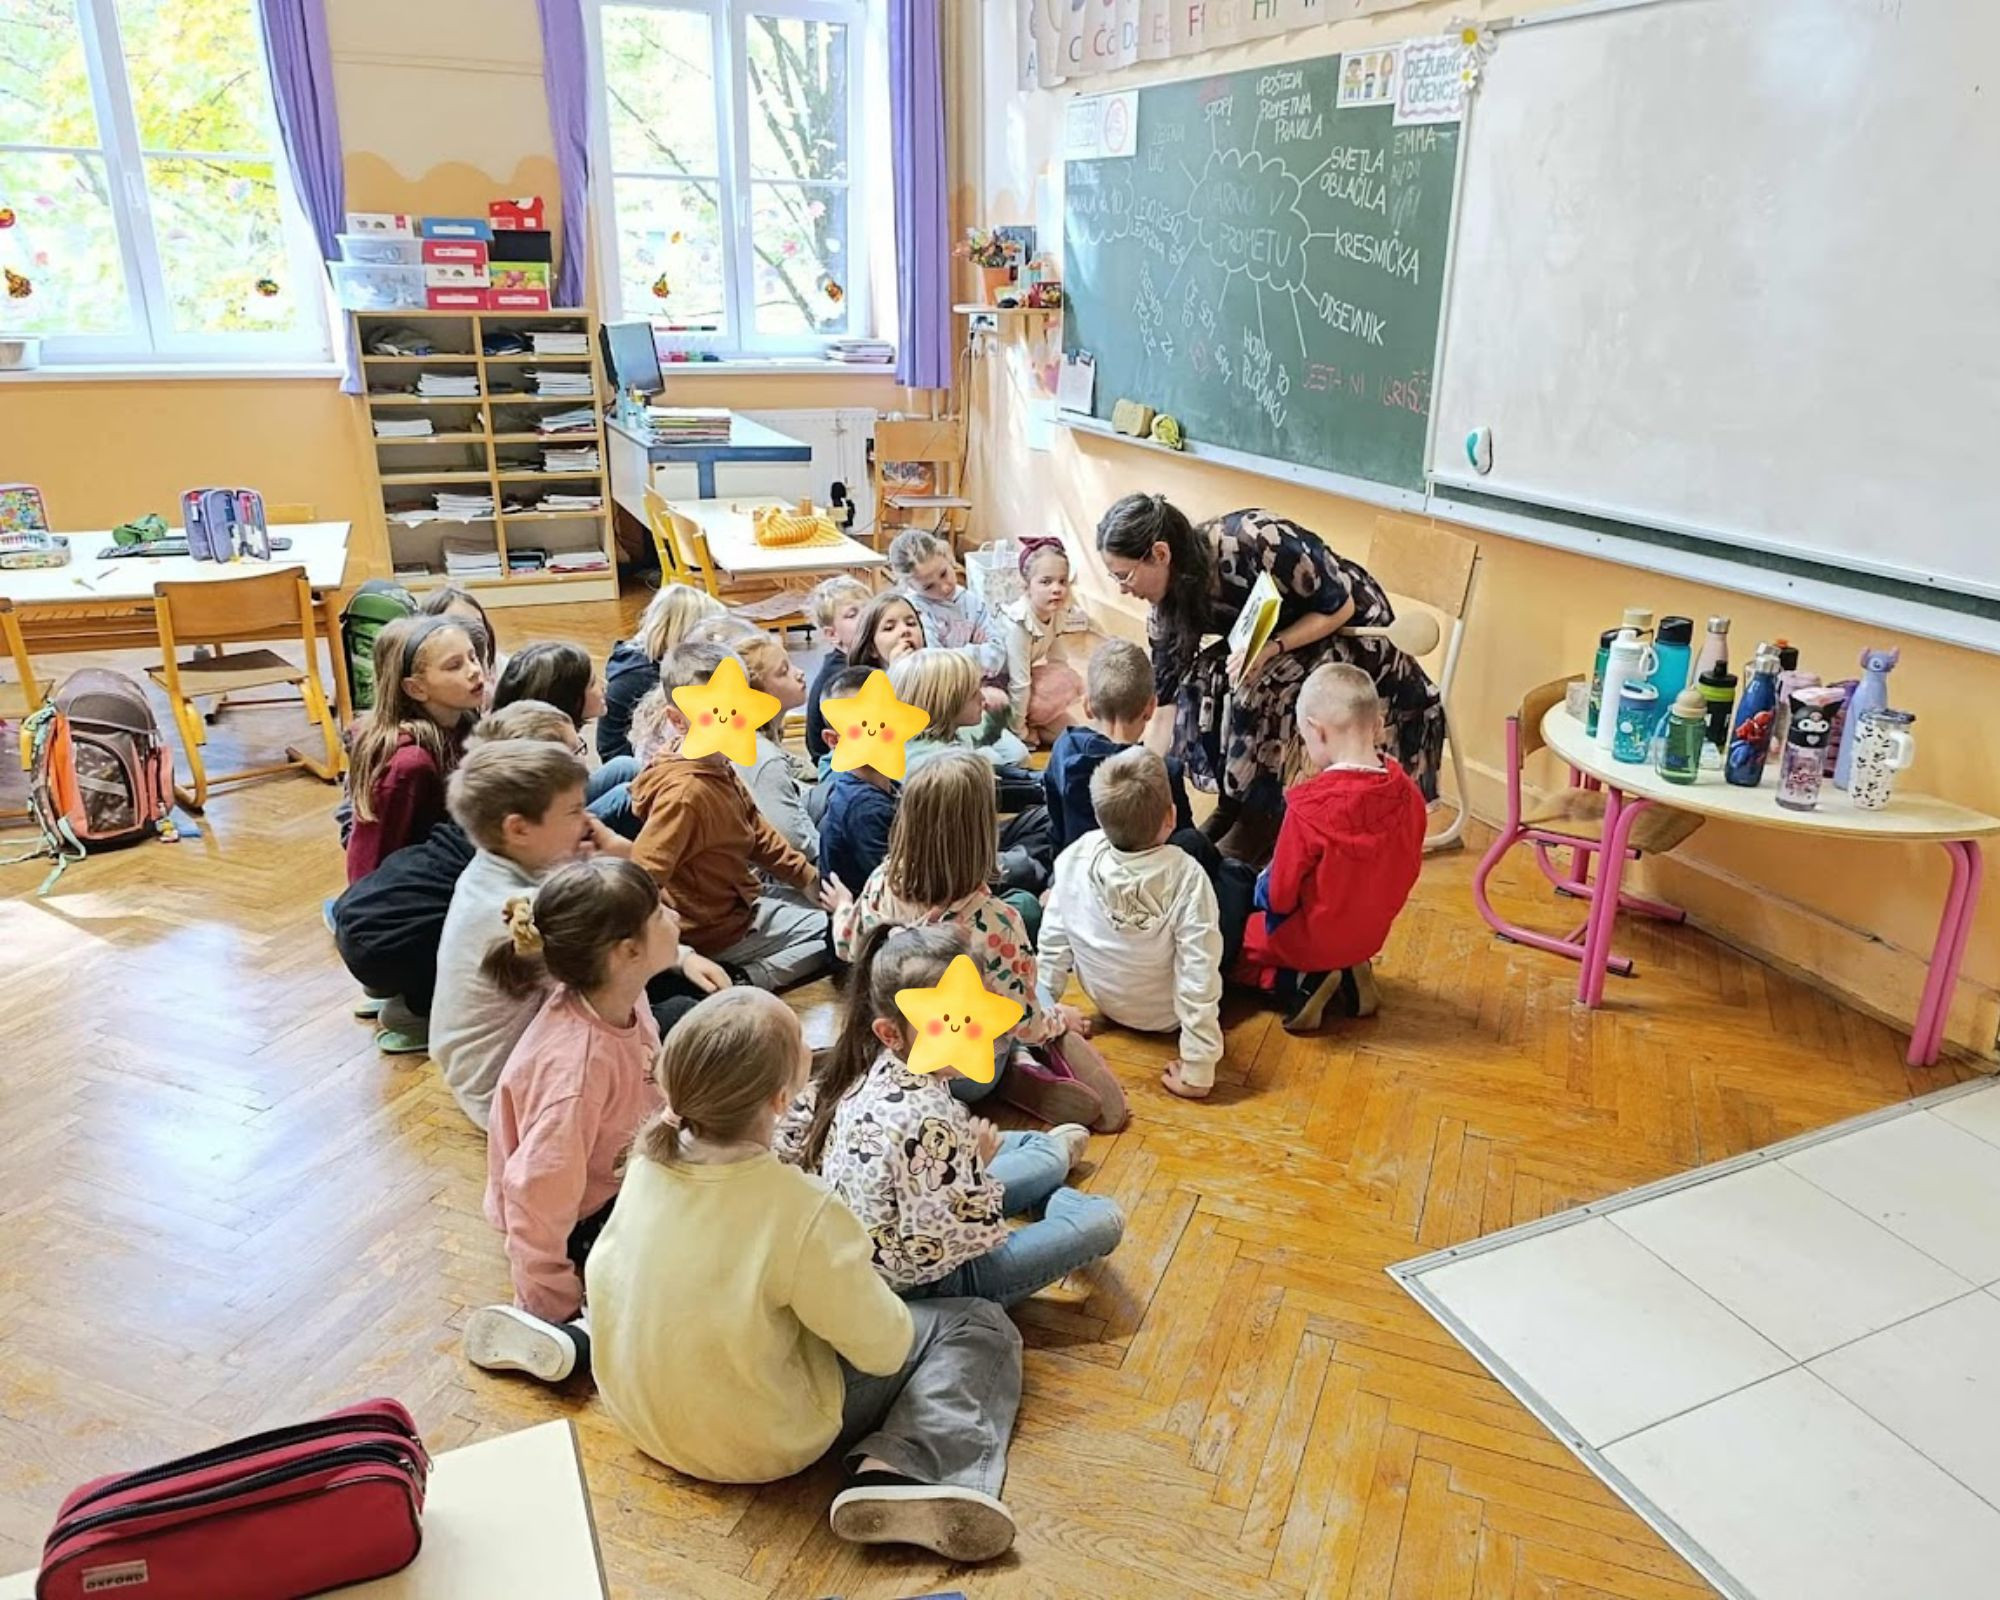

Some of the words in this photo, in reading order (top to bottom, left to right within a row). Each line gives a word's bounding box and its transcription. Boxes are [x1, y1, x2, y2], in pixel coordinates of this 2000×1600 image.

[1330, 146, 1385, 173] SVETLA
[1320, 172, 1386, 216] OBLAČILA
[1219, 222, 1292, 268] PROMETU
[1319, 292, 1387, 346] ODSEVNIK
